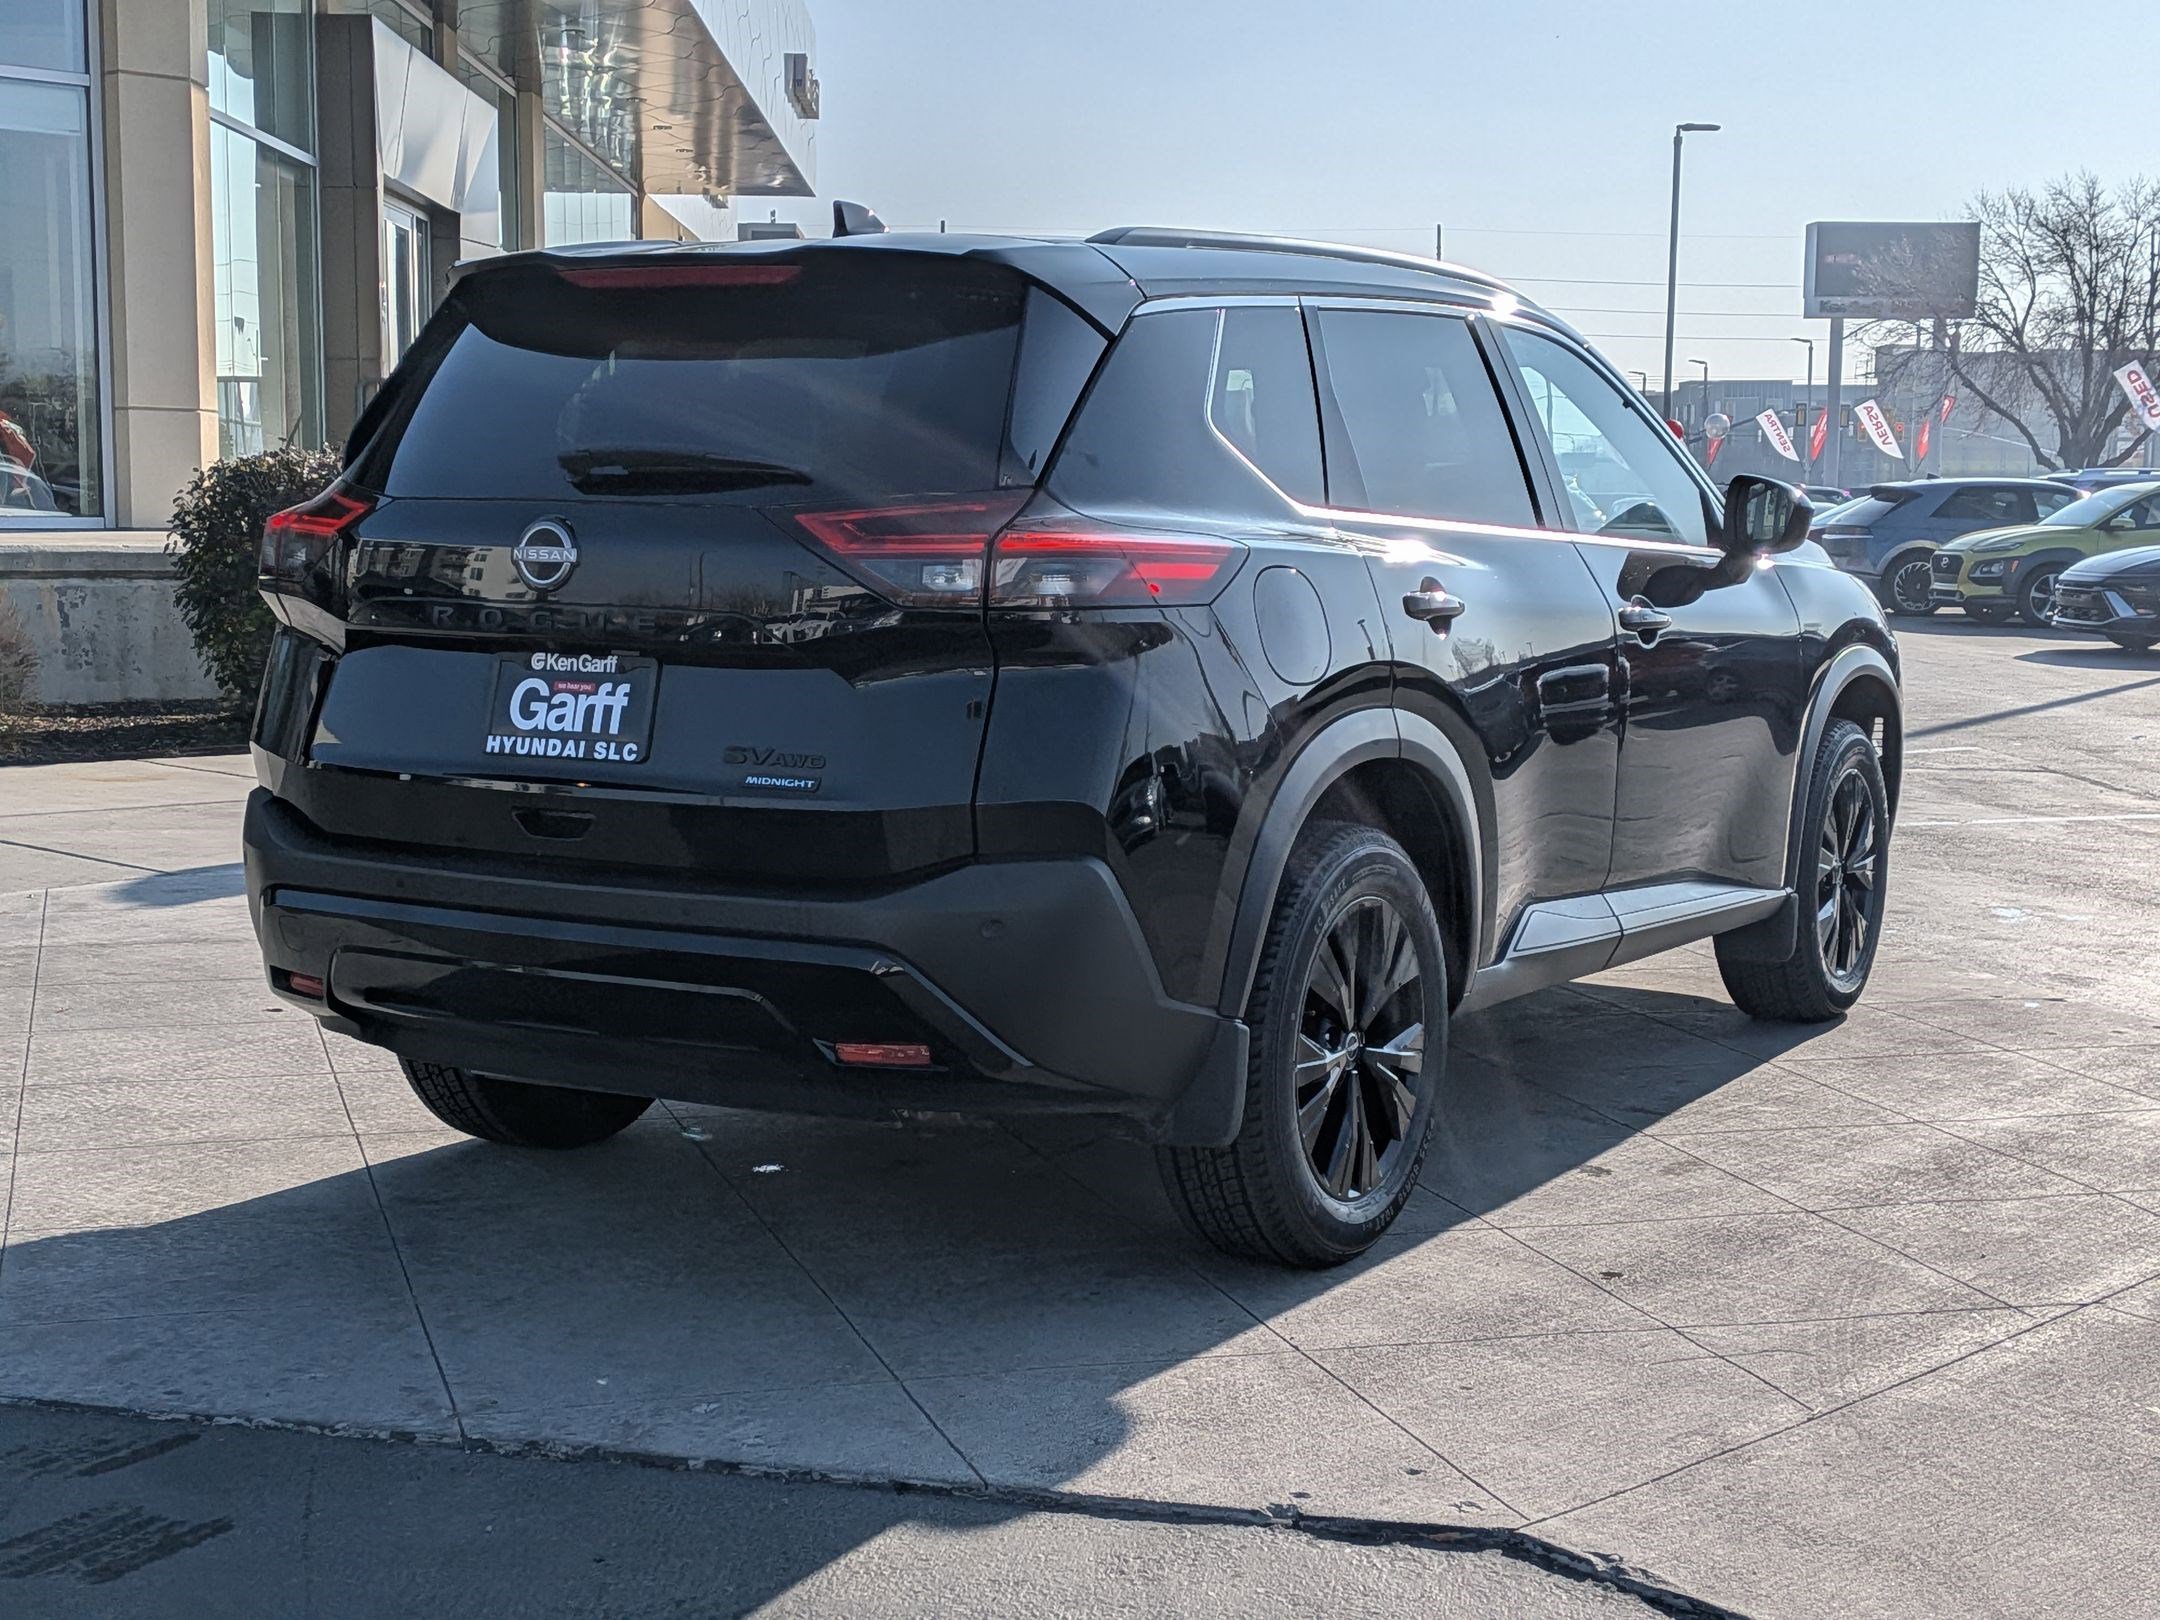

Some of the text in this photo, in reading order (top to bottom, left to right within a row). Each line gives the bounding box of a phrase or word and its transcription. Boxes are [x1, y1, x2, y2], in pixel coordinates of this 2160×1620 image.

[513, 548, 574, 561] NISSAN
[509, 677, 631, 735] Garff
[486, 735, 638, 762] HYUNDAI SLC
[745, 776, 815, 788] MIDNIGHT
